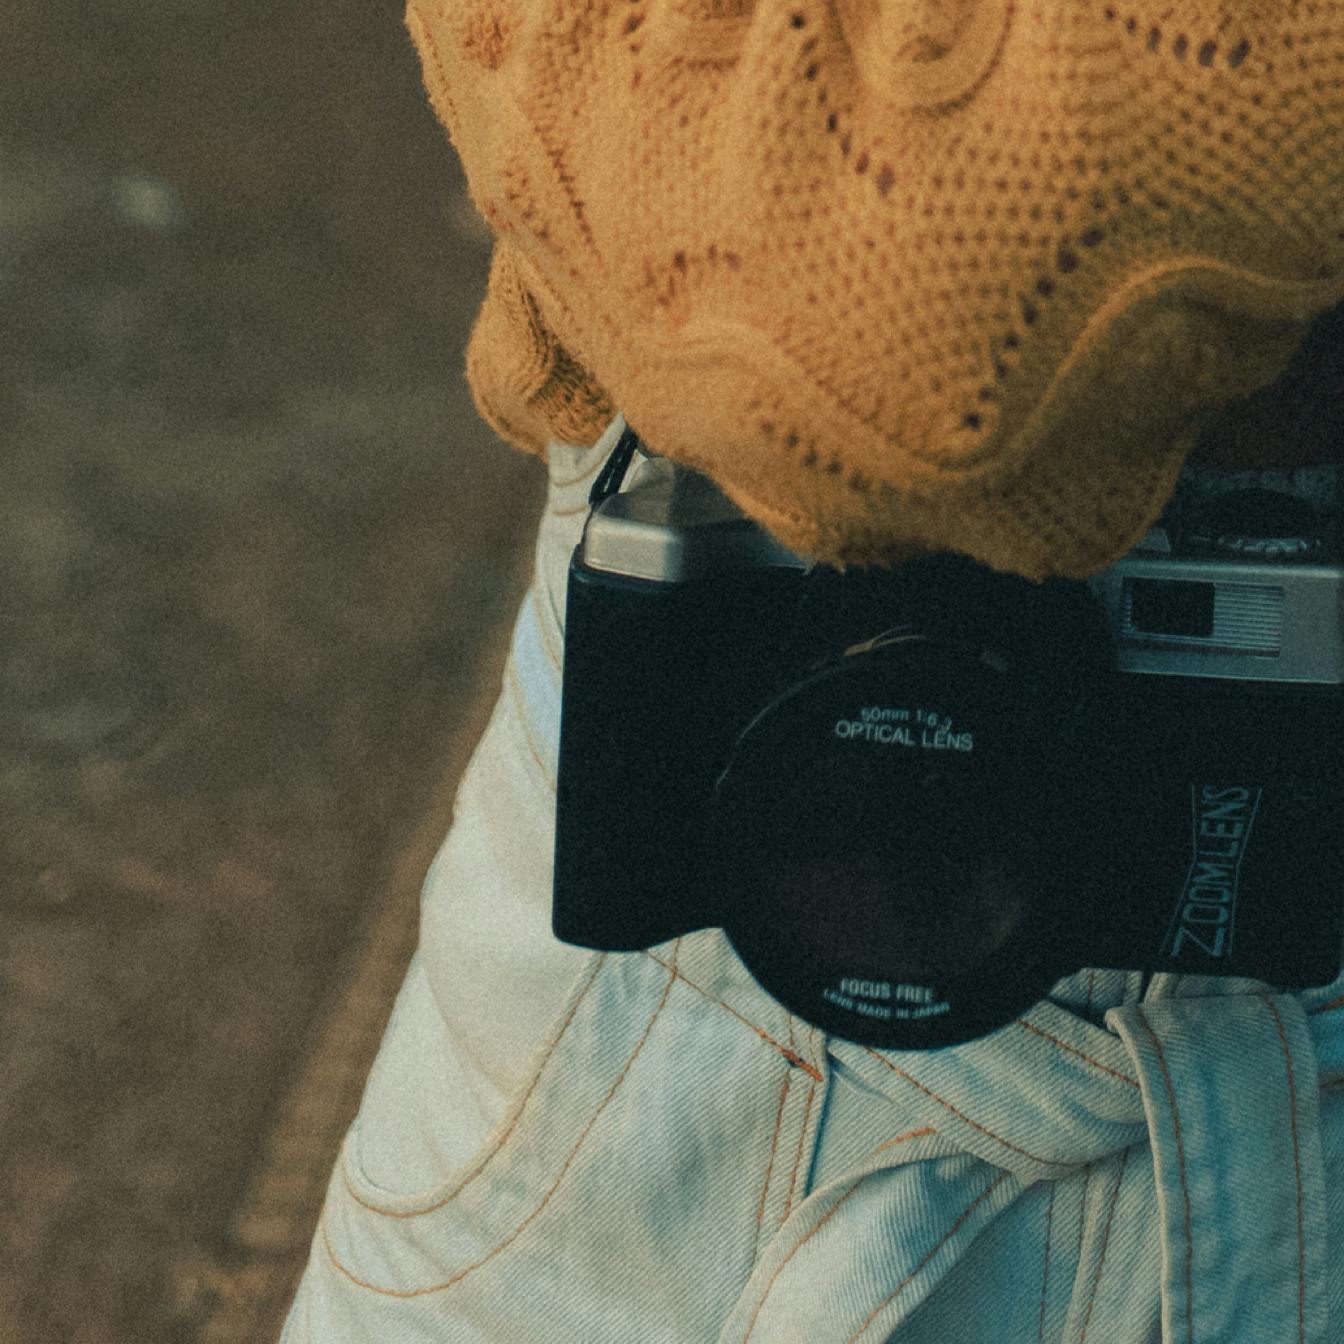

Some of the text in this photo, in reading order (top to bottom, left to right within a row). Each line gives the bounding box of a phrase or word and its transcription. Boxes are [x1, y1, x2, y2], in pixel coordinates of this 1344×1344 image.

[834, 719, 974, 752] OPTICAL LENS
[840, 978, 933, 1003] FOCUS FREE
[857, 1002, 892, 1019] MADE
[896, 1008, 910, 1019] IN
[911, 1001, 951, 1019] JAPAN
